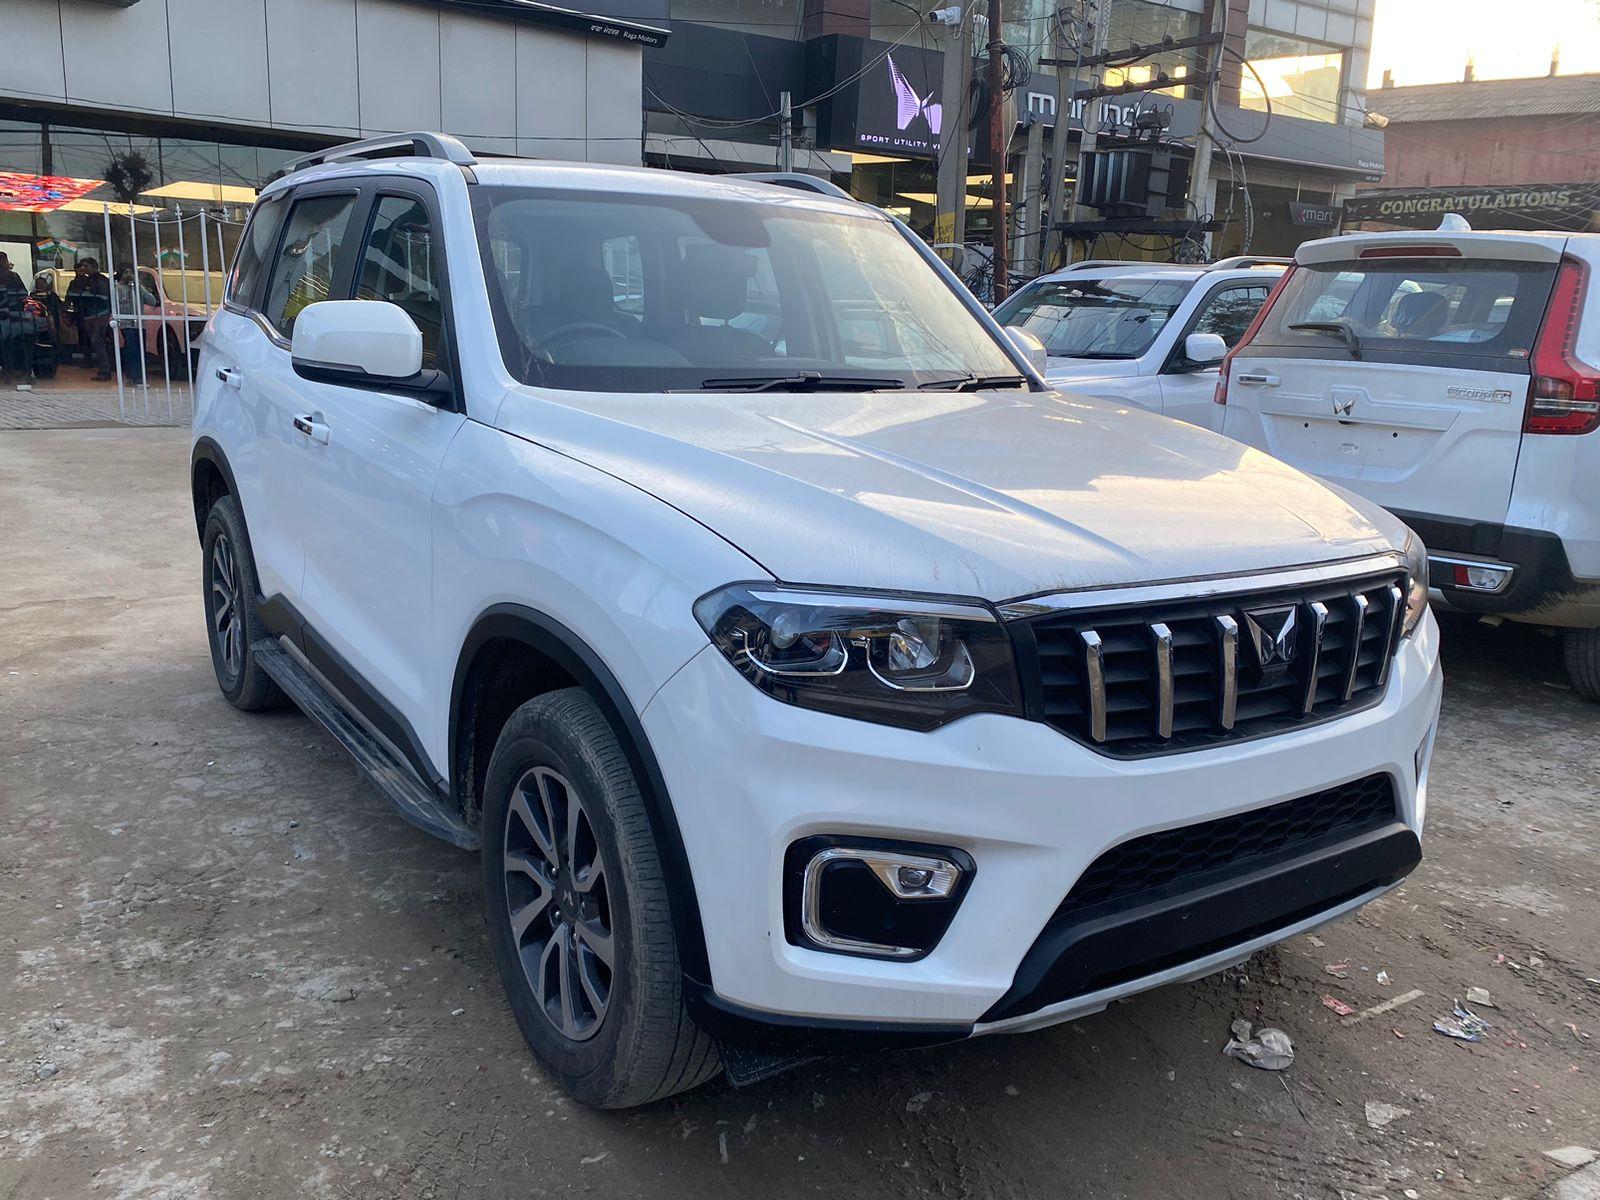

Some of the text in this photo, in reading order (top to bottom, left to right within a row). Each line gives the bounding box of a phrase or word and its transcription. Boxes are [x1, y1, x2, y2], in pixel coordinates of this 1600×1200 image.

[623, 30, 658, 44] Raga Motors
[860, 134, 928, 148] SPORT UTILITY
[1380, 191, 1570, 215] CONGRATULATIONS
